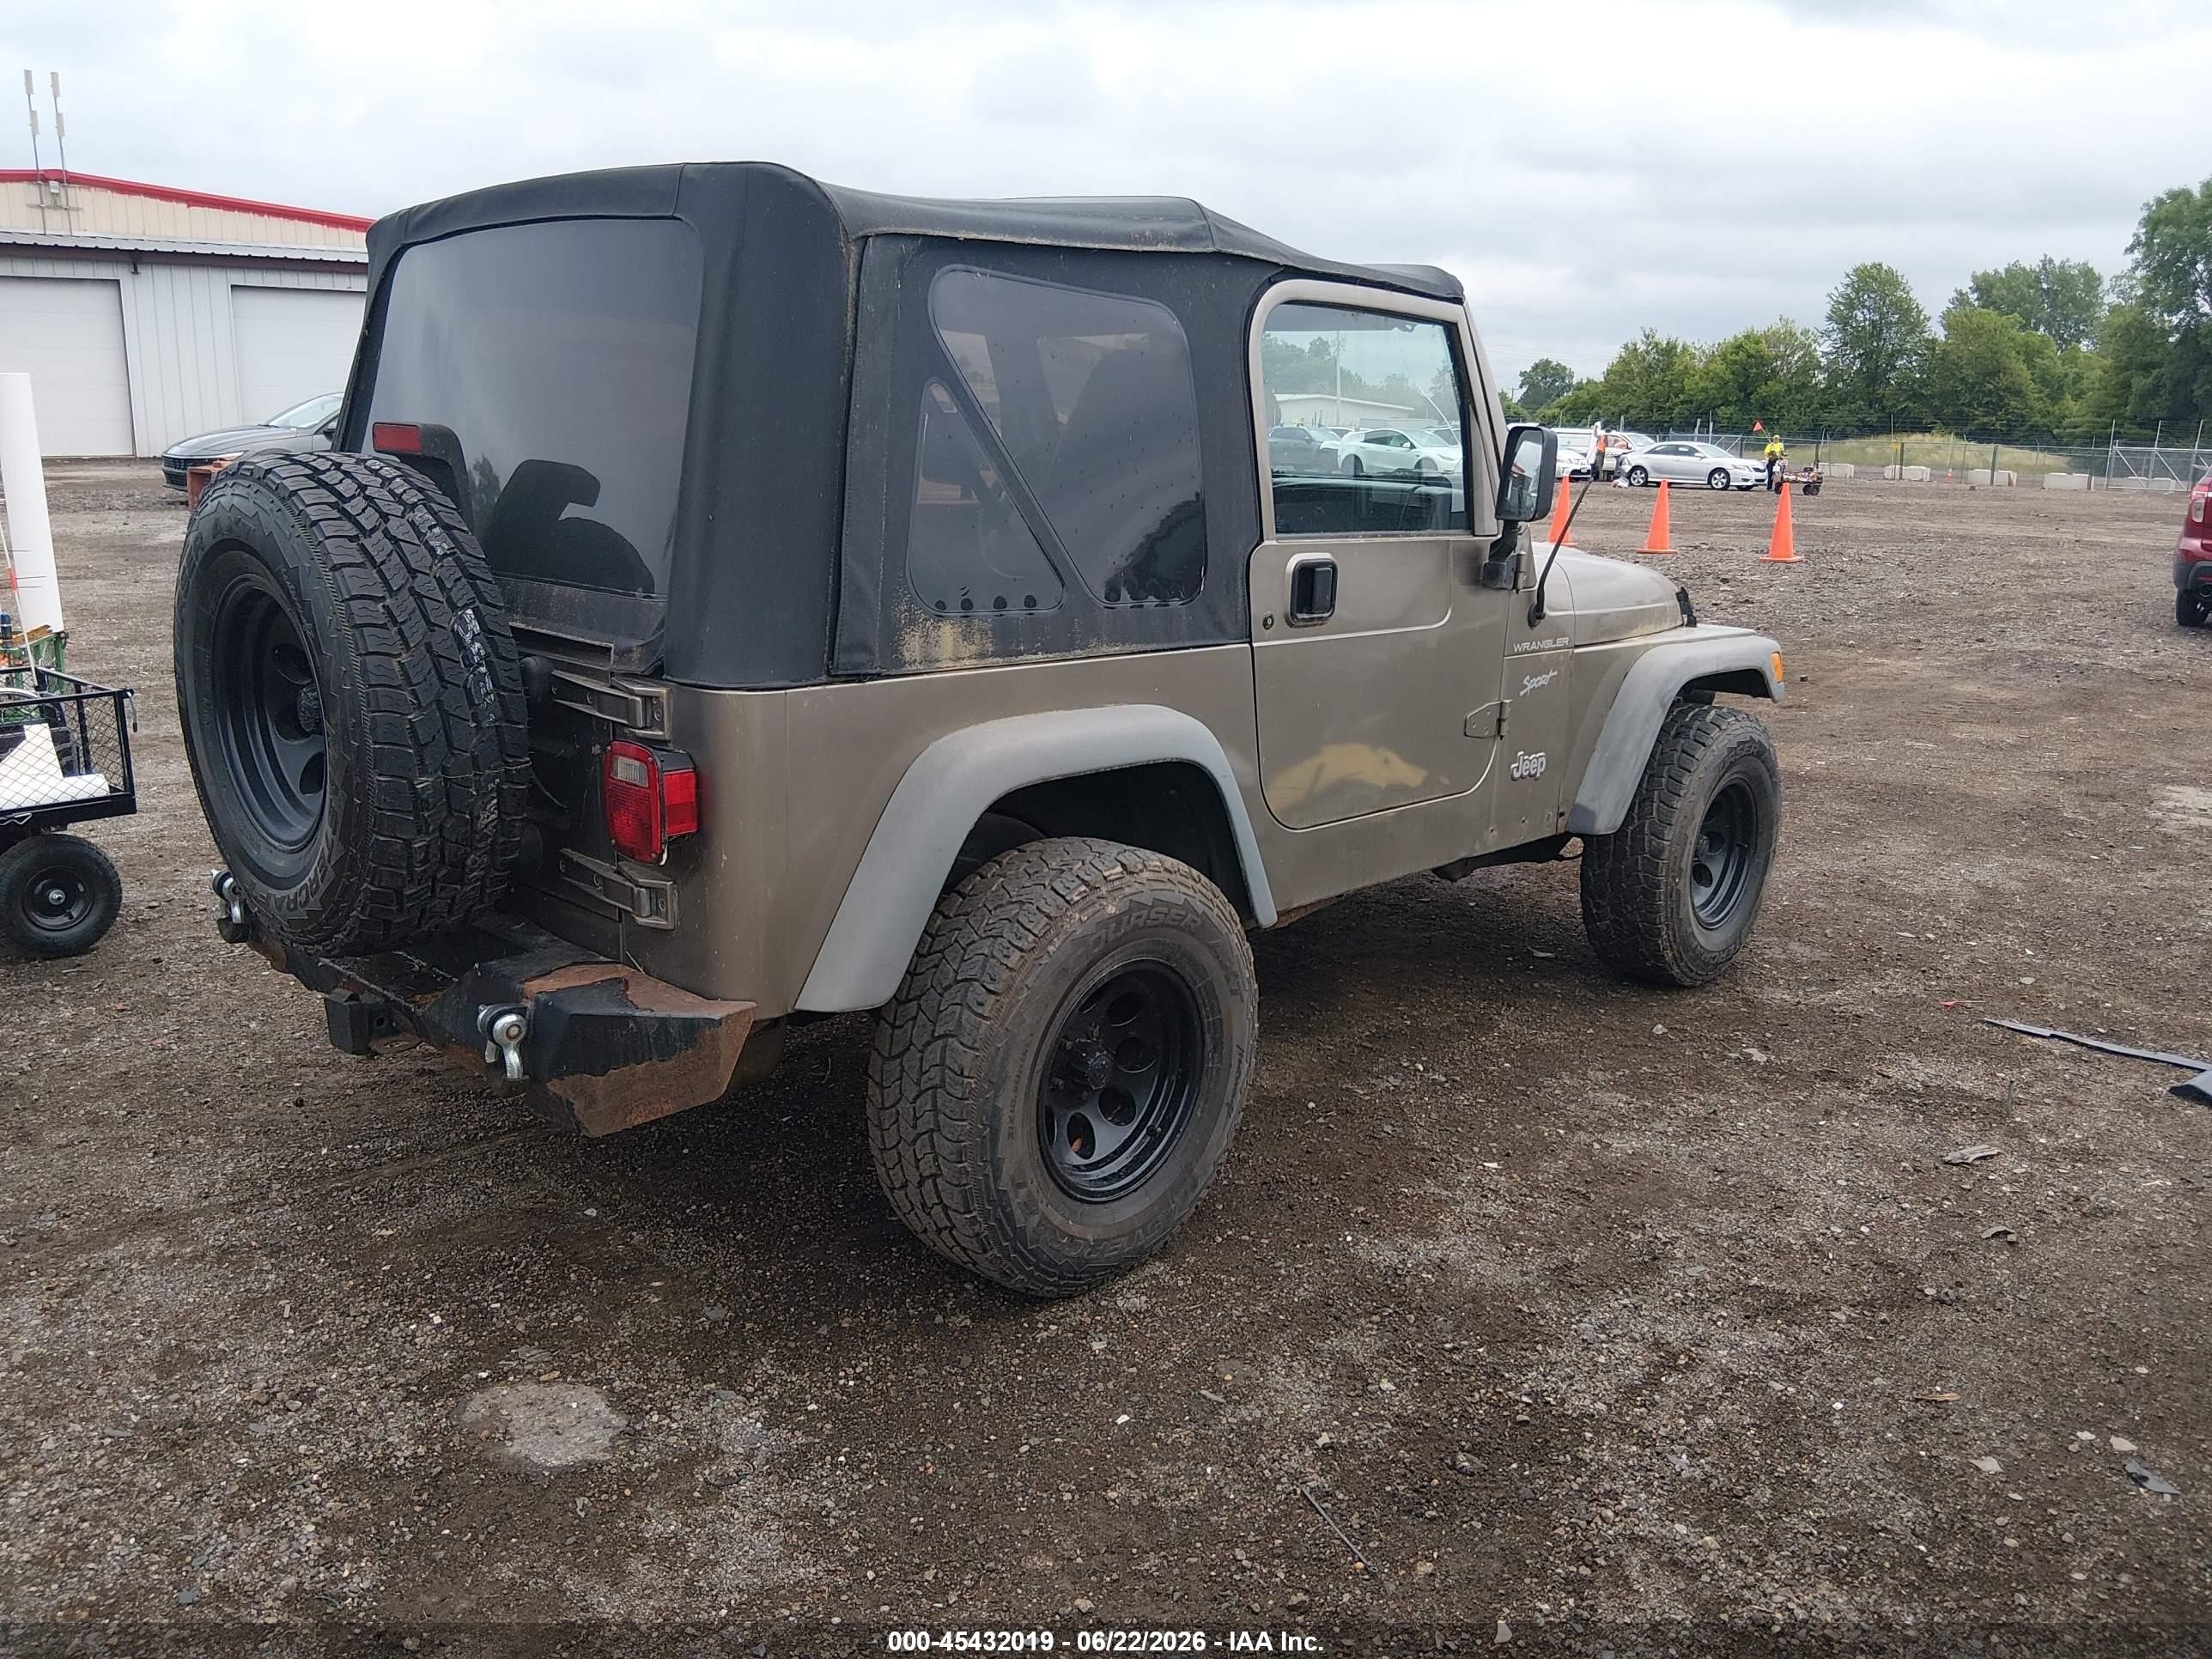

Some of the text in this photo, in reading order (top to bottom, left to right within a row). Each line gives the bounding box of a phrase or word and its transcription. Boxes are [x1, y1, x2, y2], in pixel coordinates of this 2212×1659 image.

[1513, 637, 1569, 653] WRANGLER
[1519, 669, 1558, 696] Sport
[1510, 750, 1546, 781] Jeep
